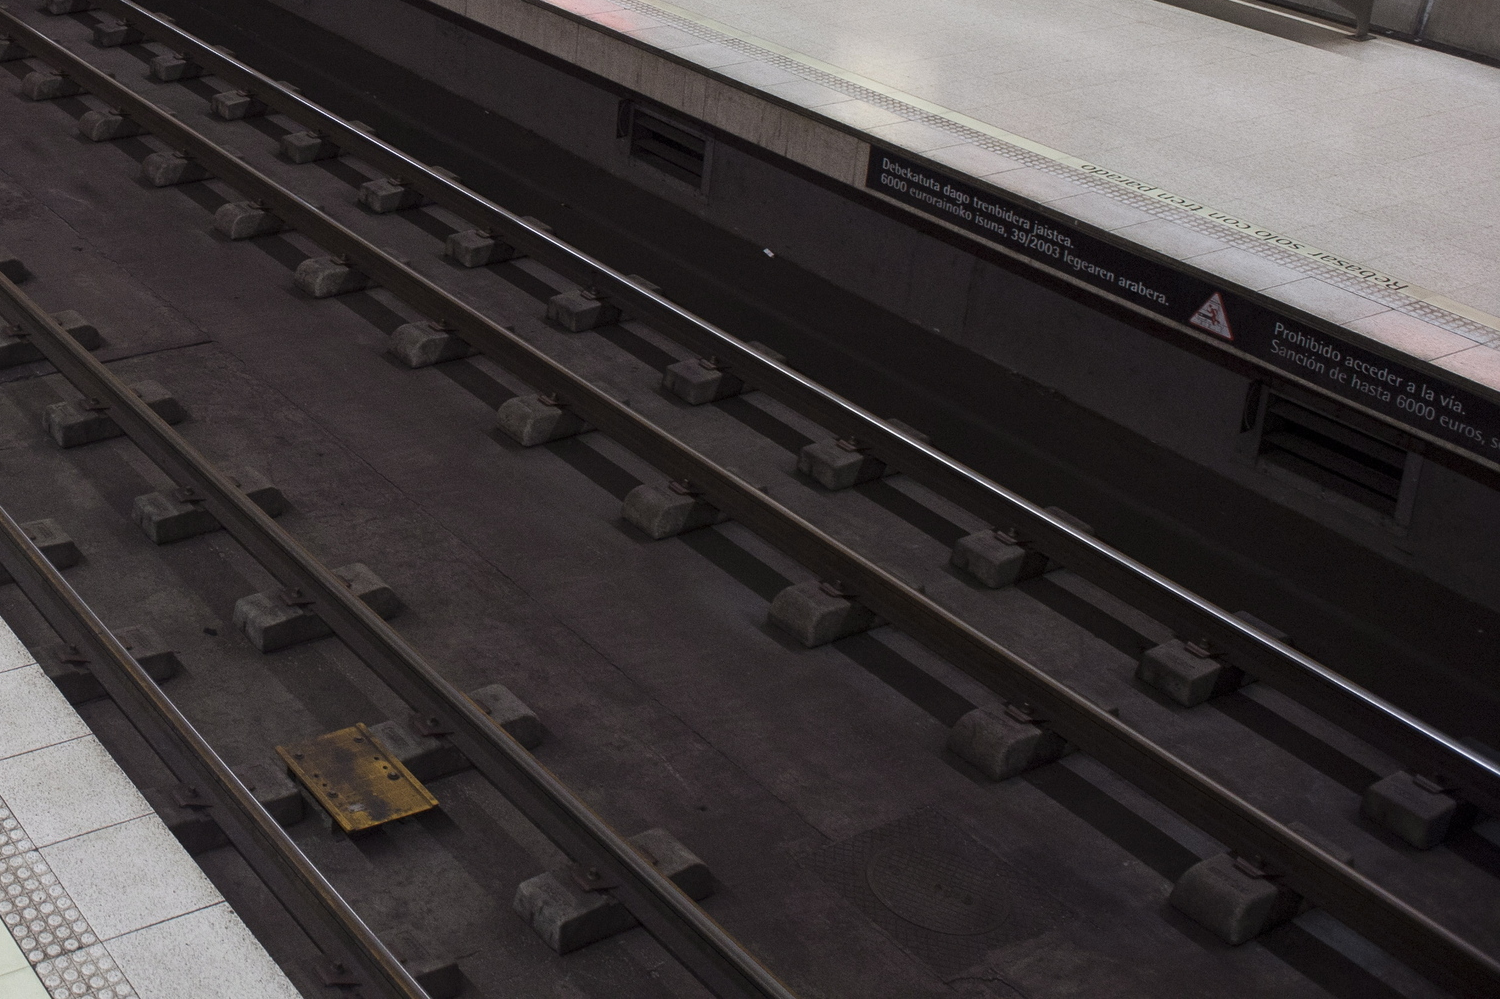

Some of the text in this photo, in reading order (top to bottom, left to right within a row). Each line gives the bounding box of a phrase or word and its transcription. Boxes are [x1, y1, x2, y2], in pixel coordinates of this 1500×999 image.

[880, 173, 1170, 306] 6000 eurorainoko isuna, 39/2003 legearen arabera.
[882, 157, 1074, 249] Debekatuta dago trenbidera jaistea.
[1080, 163, 1410, 292] Rebasar solo con tren parado
[1270, 339, 1325, 374] Sanción
[1329, 366, 1347, 384] de
[1351, 375, 1391, 402] hasta
[1396, 394, 1436, 421] 6000
[1439, 415, 1486, 445] euros,
[1274, 321, 1467, 415] Prohibido acceder a la vía.
